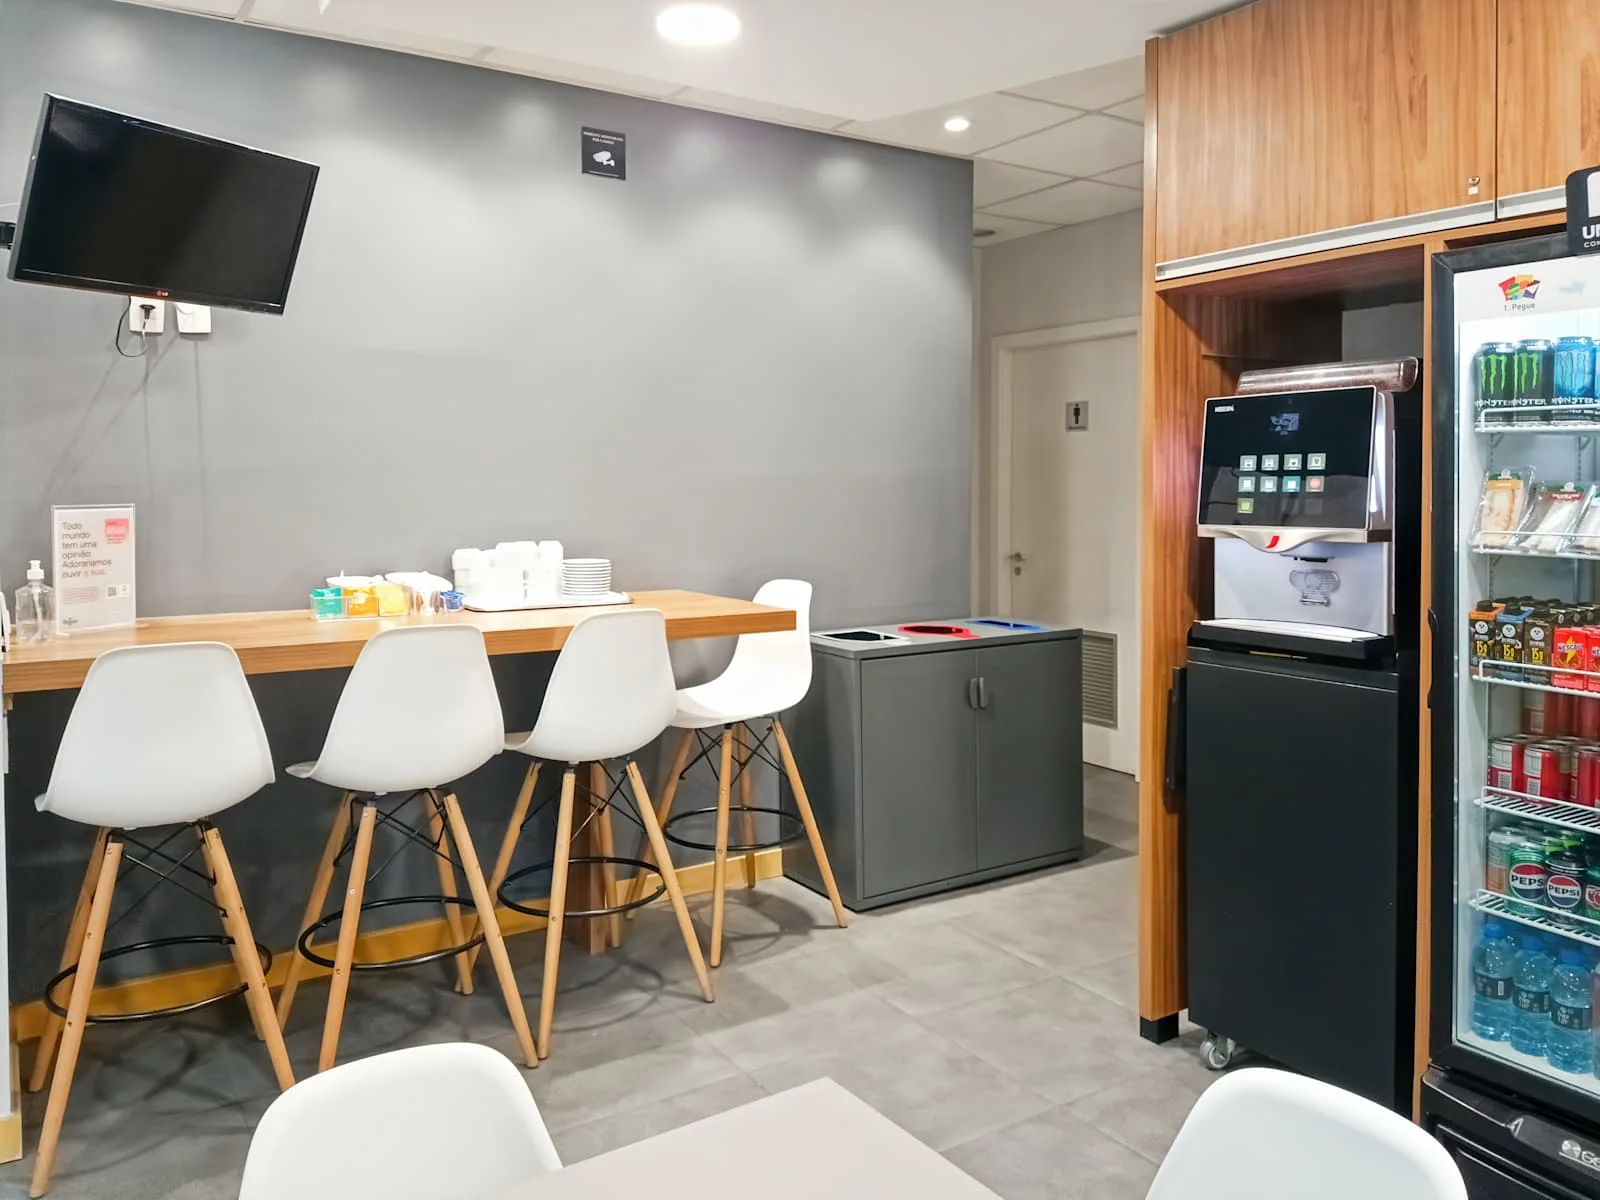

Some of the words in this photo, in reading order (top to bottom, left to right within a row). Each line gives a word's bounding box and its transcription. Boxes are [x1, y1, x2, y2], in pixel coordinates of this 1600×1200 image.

[1512, 303, 1535, 311] Pegue
[62, 522, 82, 530] Todo
[62, 532, 90, 540] mundo
[62, 570, 80, 578] ouvir
[1511, 874, 1544, 887] PEPS
[1549, 884, 1580, 897] PEPSI
